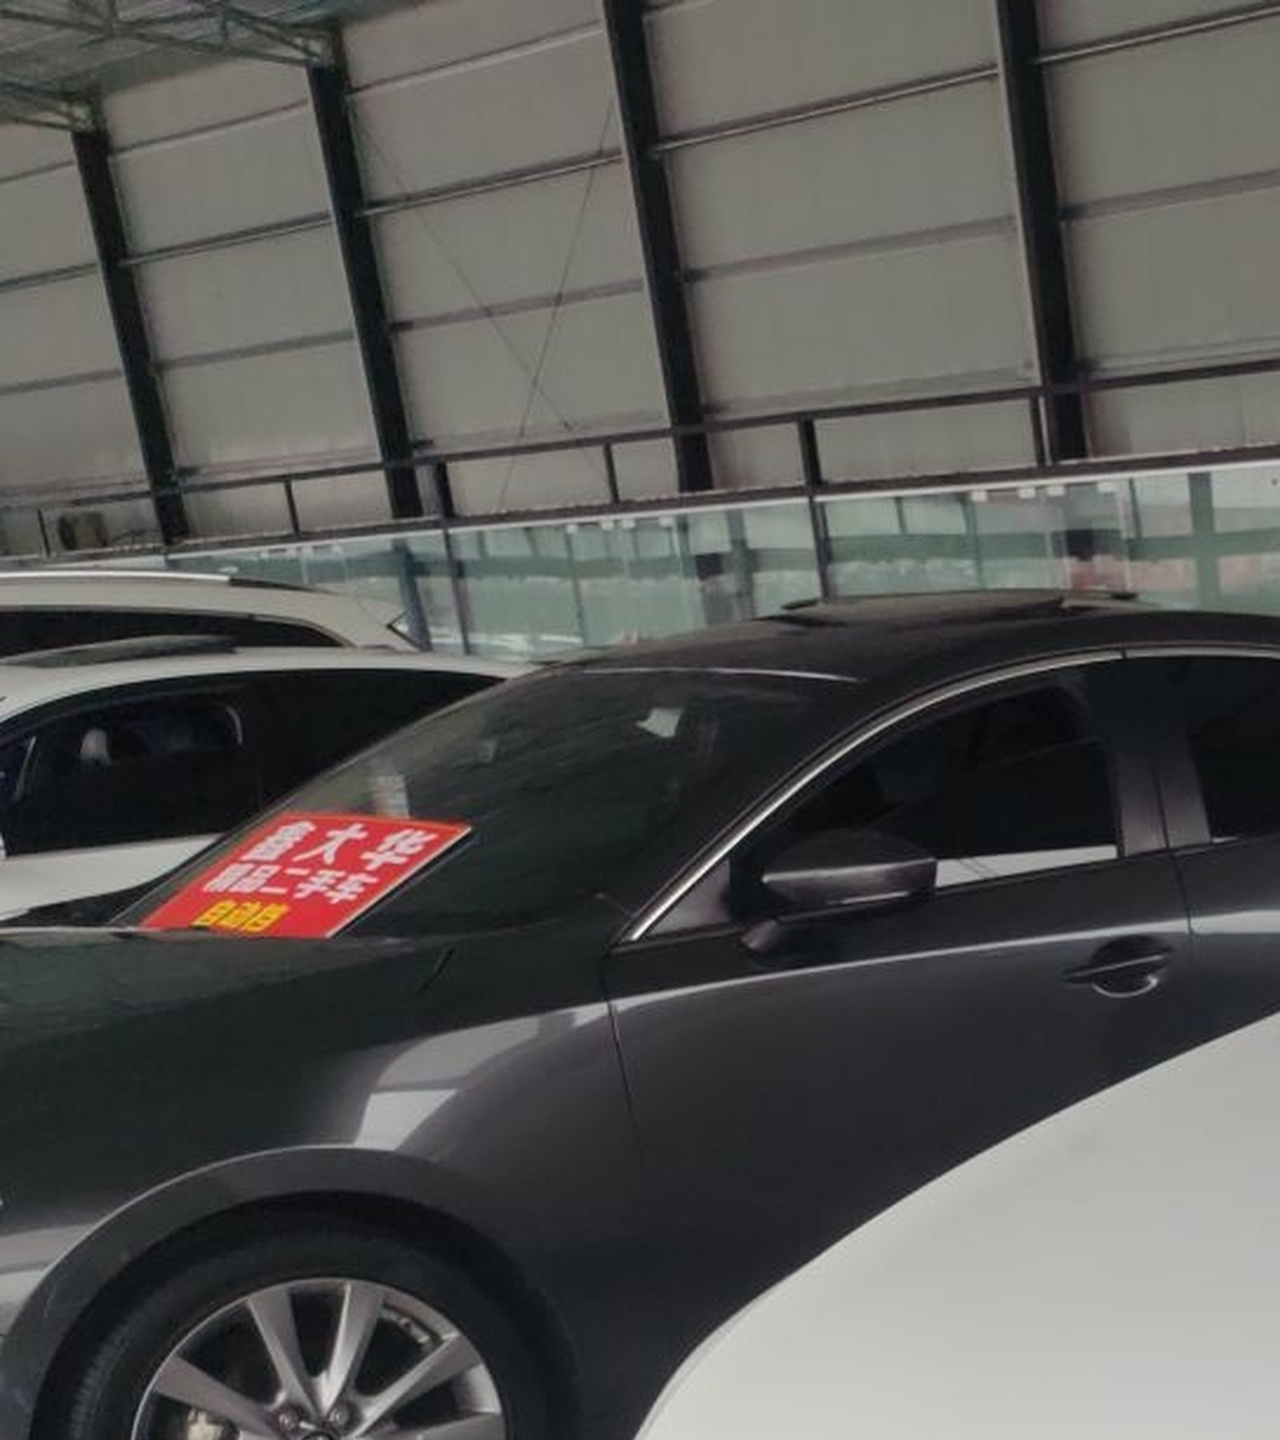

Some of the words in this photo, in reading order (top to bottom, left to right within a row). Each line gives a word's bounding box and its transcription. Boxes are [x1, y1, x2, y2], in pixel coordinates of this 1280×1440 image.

[240, 820, 439, 870] 鑫大华
[202, 863, 379, 904] 精品二手车
